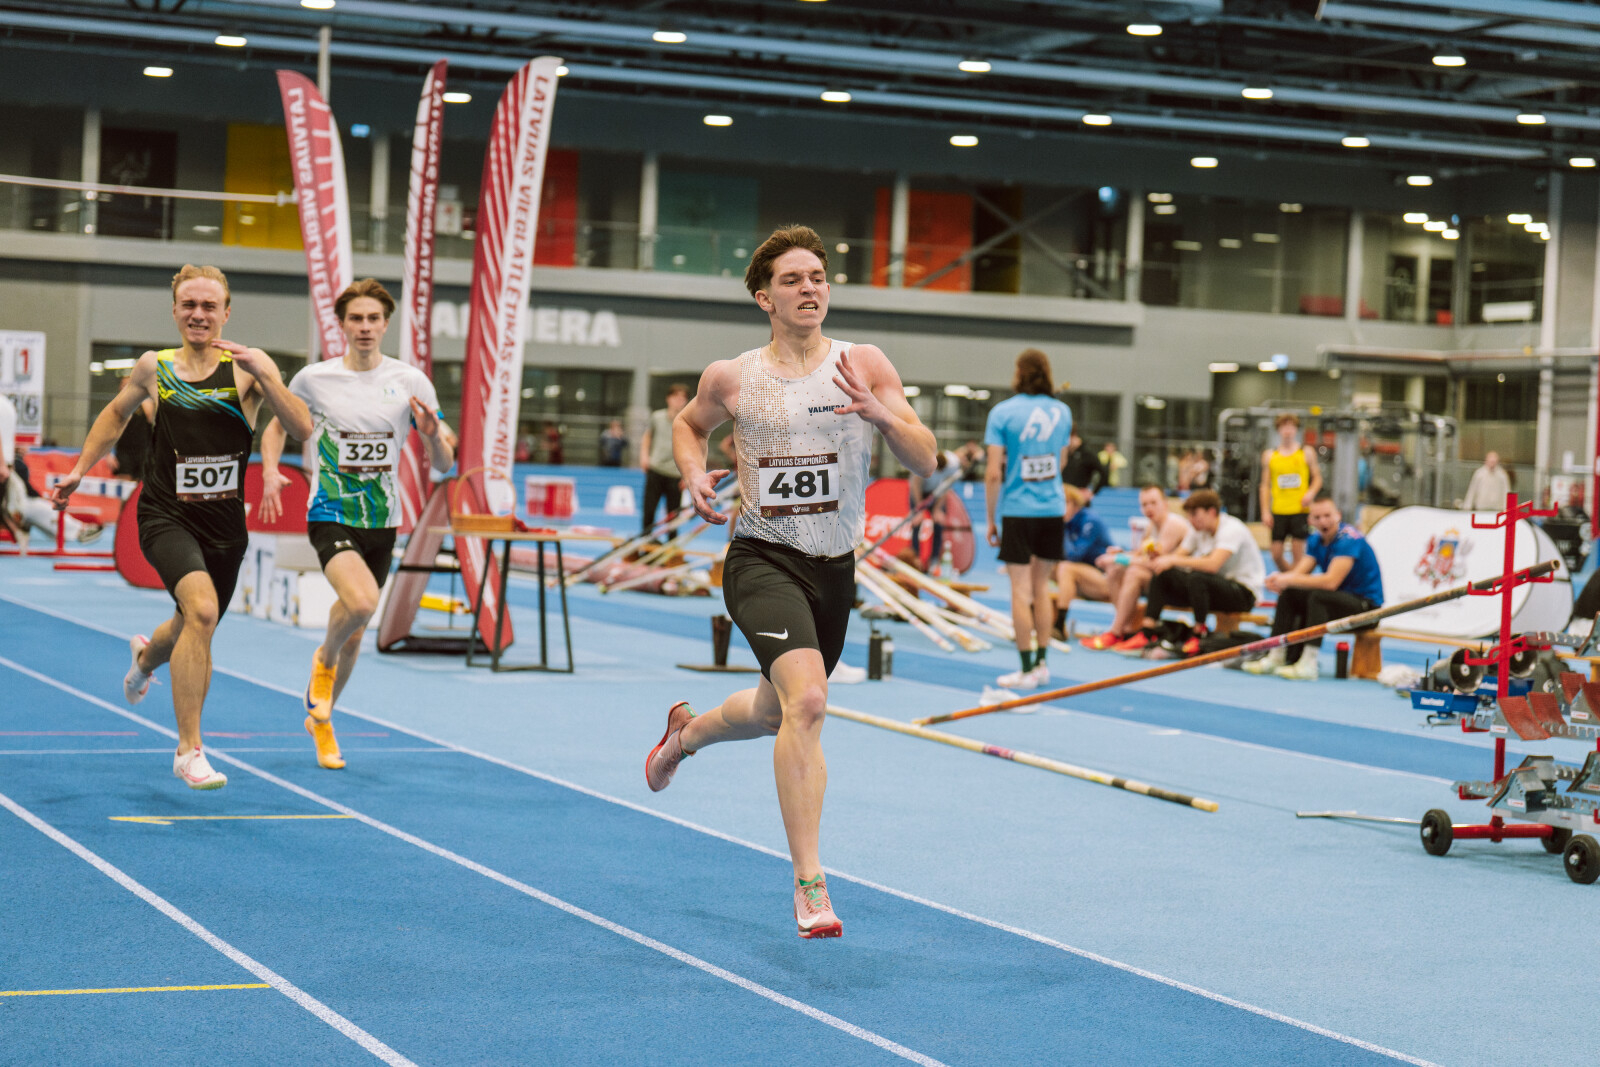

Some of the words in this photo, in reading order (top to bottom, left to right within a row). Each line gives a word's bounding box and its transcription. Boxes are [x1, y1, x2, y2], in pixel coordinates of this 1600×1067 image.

[521, 75, 549, 179] LATVIJAS
[345, 443, 388, 461] 329
[768, 458, 794, 467] LATVIJAS
[795, 454, 829, 466] ČEMPIONĀTS
[182, 465, 234, 488] 507
[768, 469, 830, 499] 481
